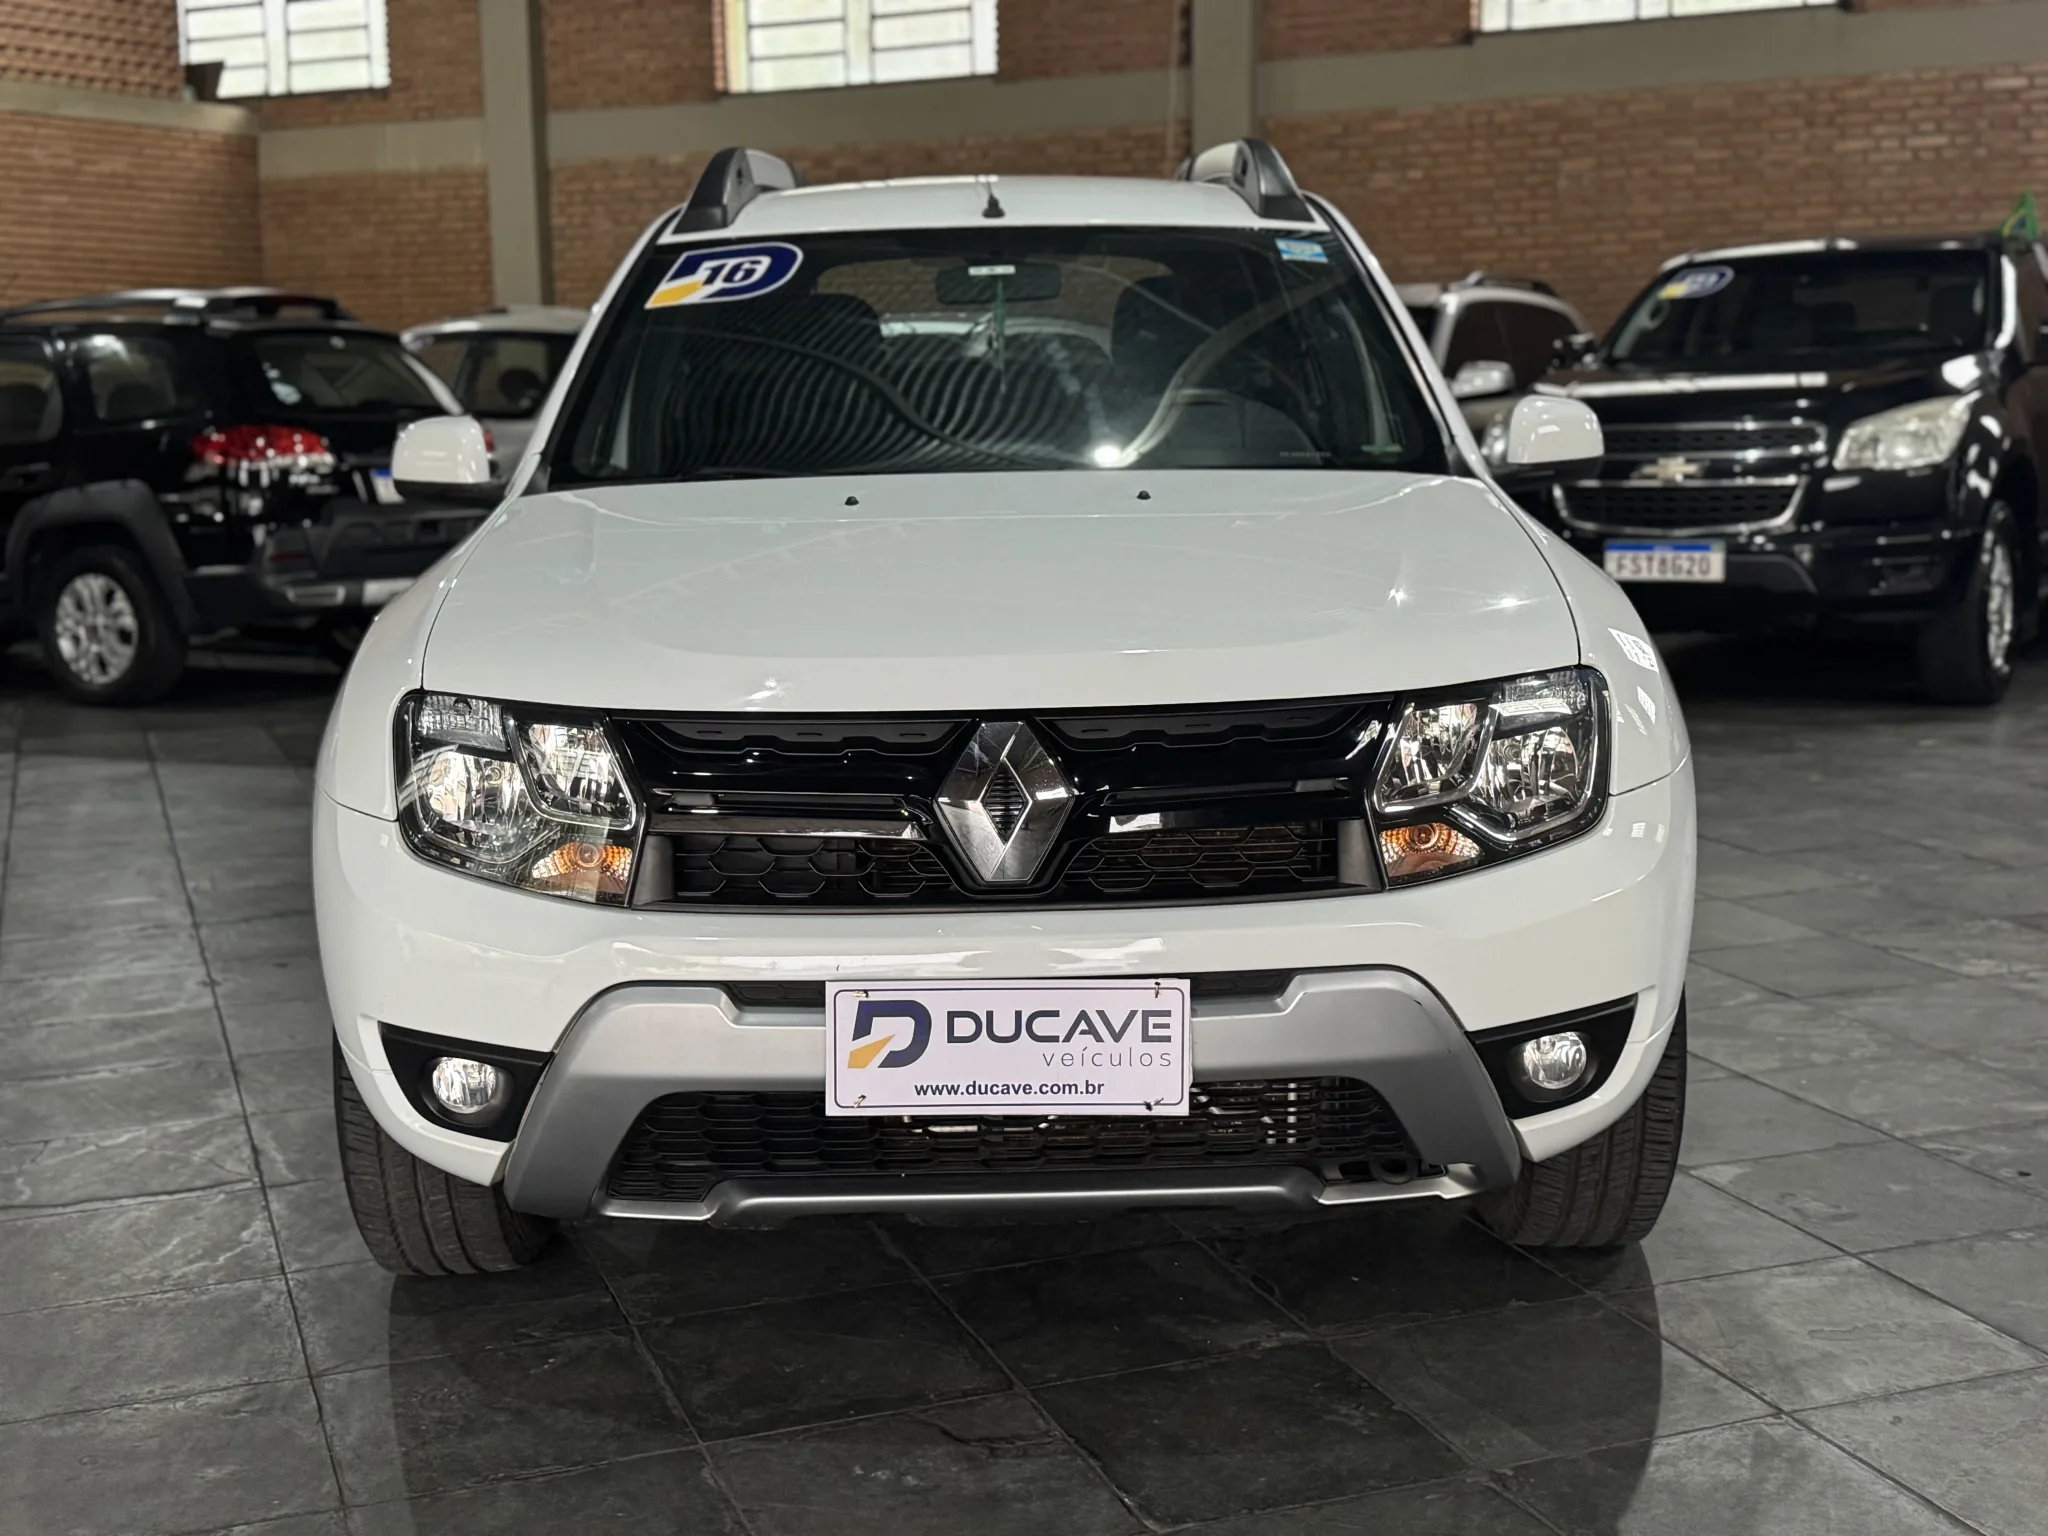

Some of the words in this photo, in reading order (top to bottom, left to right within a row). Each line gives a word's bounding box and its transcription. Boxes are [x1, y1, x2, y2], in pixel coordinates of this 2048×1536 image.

[702, 259, 763, 286] 16
[946, 1009, 1172, 1044] DUCAVE
[1042, 1047, 1171, 1067] veículos
[914, 1079, 1105, 1096] www.ducave.com.br
